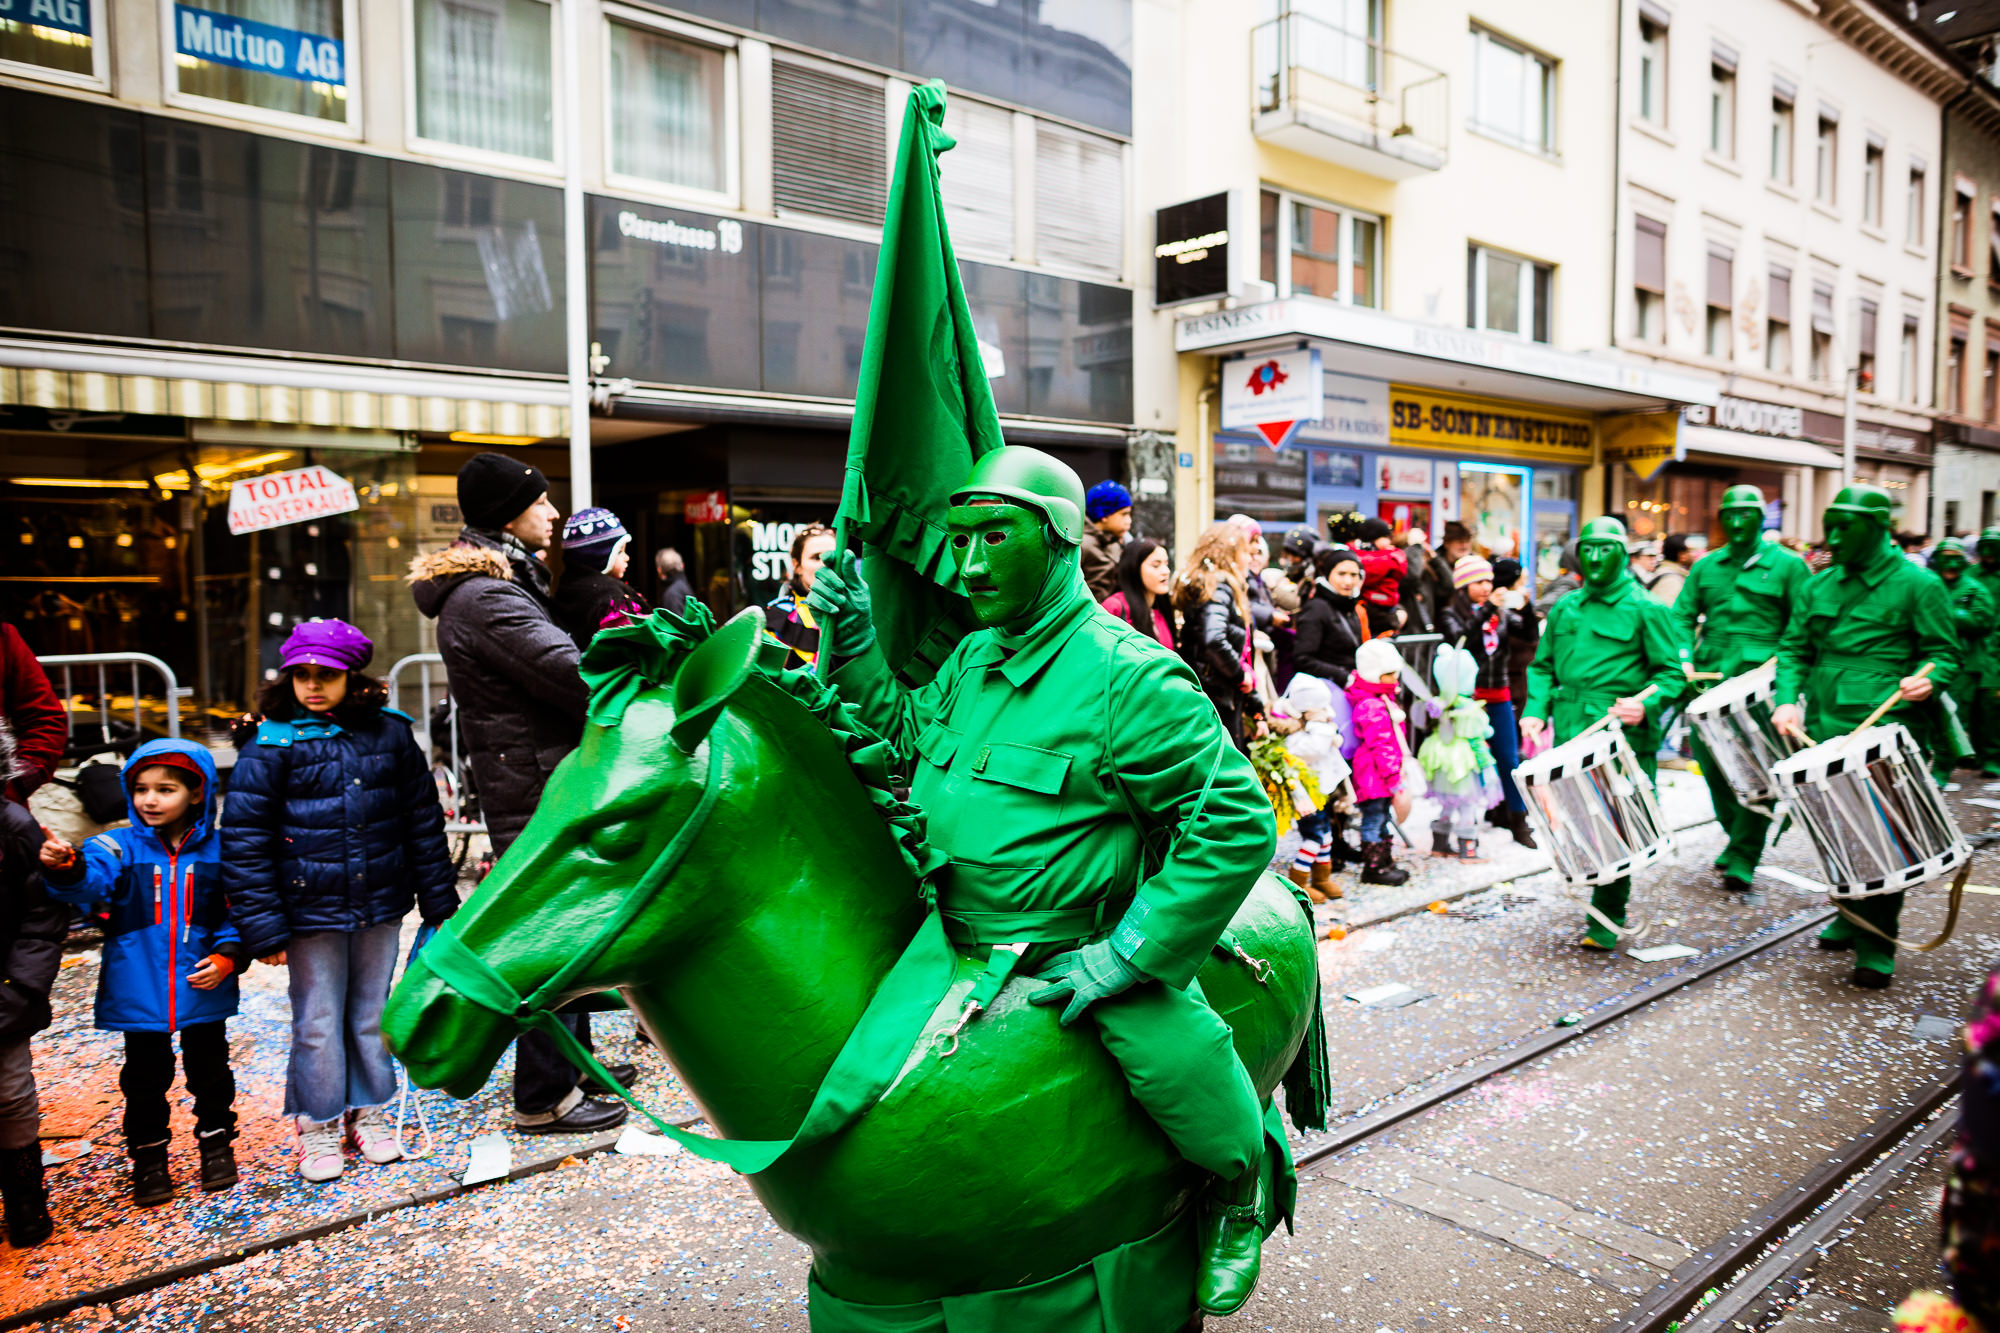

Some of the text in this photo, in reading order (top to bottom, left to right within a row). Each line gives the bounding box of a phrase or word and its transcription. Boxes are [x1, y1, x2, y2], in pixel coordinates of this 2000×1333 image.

[181, 11, 339, 80] Mutuo AG
[618, 211, 742, 254] Clarastrasse 19
[1392, 401, 1590, 448] SB-SONNENSTUDIO
[231, 486, 354, 529] AUSVERKAUF
[243, 471, 331, 502] TOTAL
